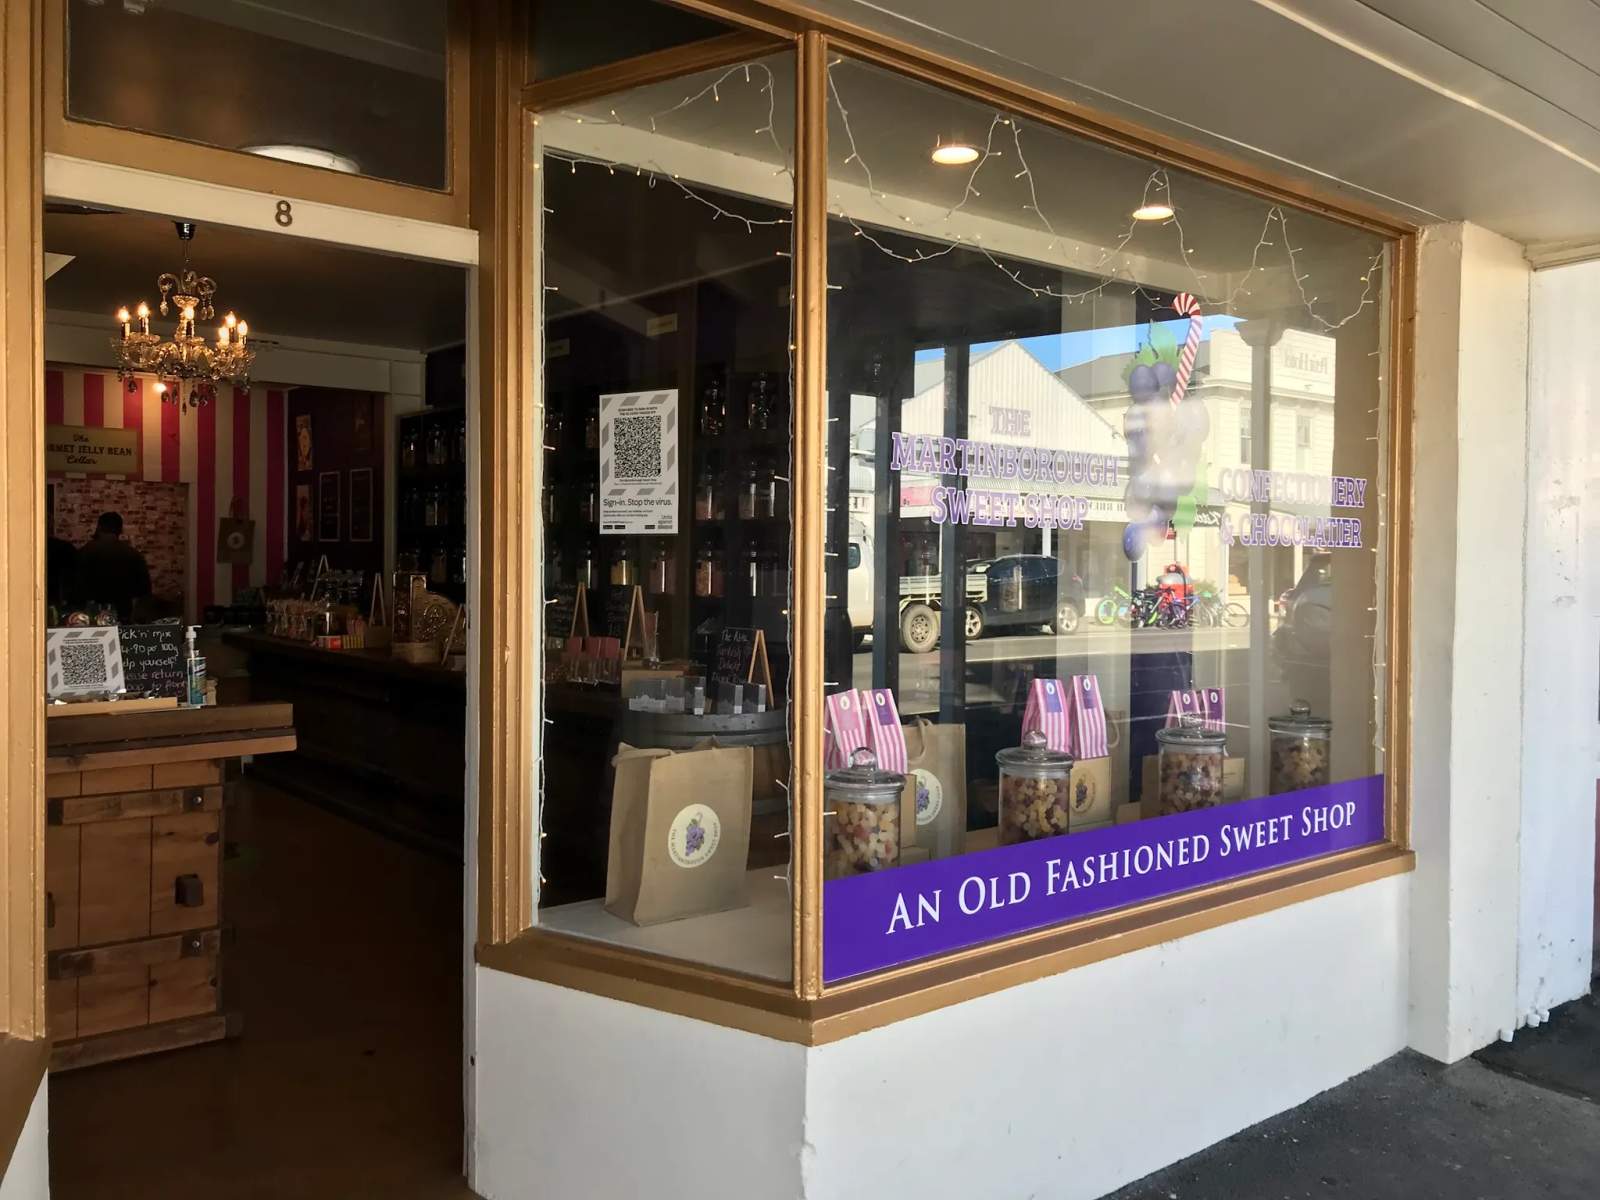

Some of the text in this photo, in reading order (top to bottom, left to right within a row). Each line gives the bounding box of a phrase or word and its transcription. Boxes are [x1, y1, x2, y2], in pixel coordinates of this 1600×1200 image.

[275, 200, 293, 227] 8
[988, 406, 1032, 438] THE
[66, 454, 97, 464] Cellar
[78, 445, 105, 455] JELLY
[107, 447, 132, 456] BEAN
[890, 431, 1119, 487] MARTINBOROUGH
[628, 498, 643, 508] Stop
[644, 498, 655, 506] the
[655, 497, 672, 506] virus.
[1219, 467, 1367, 508] CONFECTIONERY
[929, 485, 1090, 531] SWEET SHOP
[1220, 512, 1362, 548] & CHOCOLATIER
[152, 630, 171, 643] mix
[885, 801, 1357, 935] AN OLD FASHIONED SWEET SHOP
